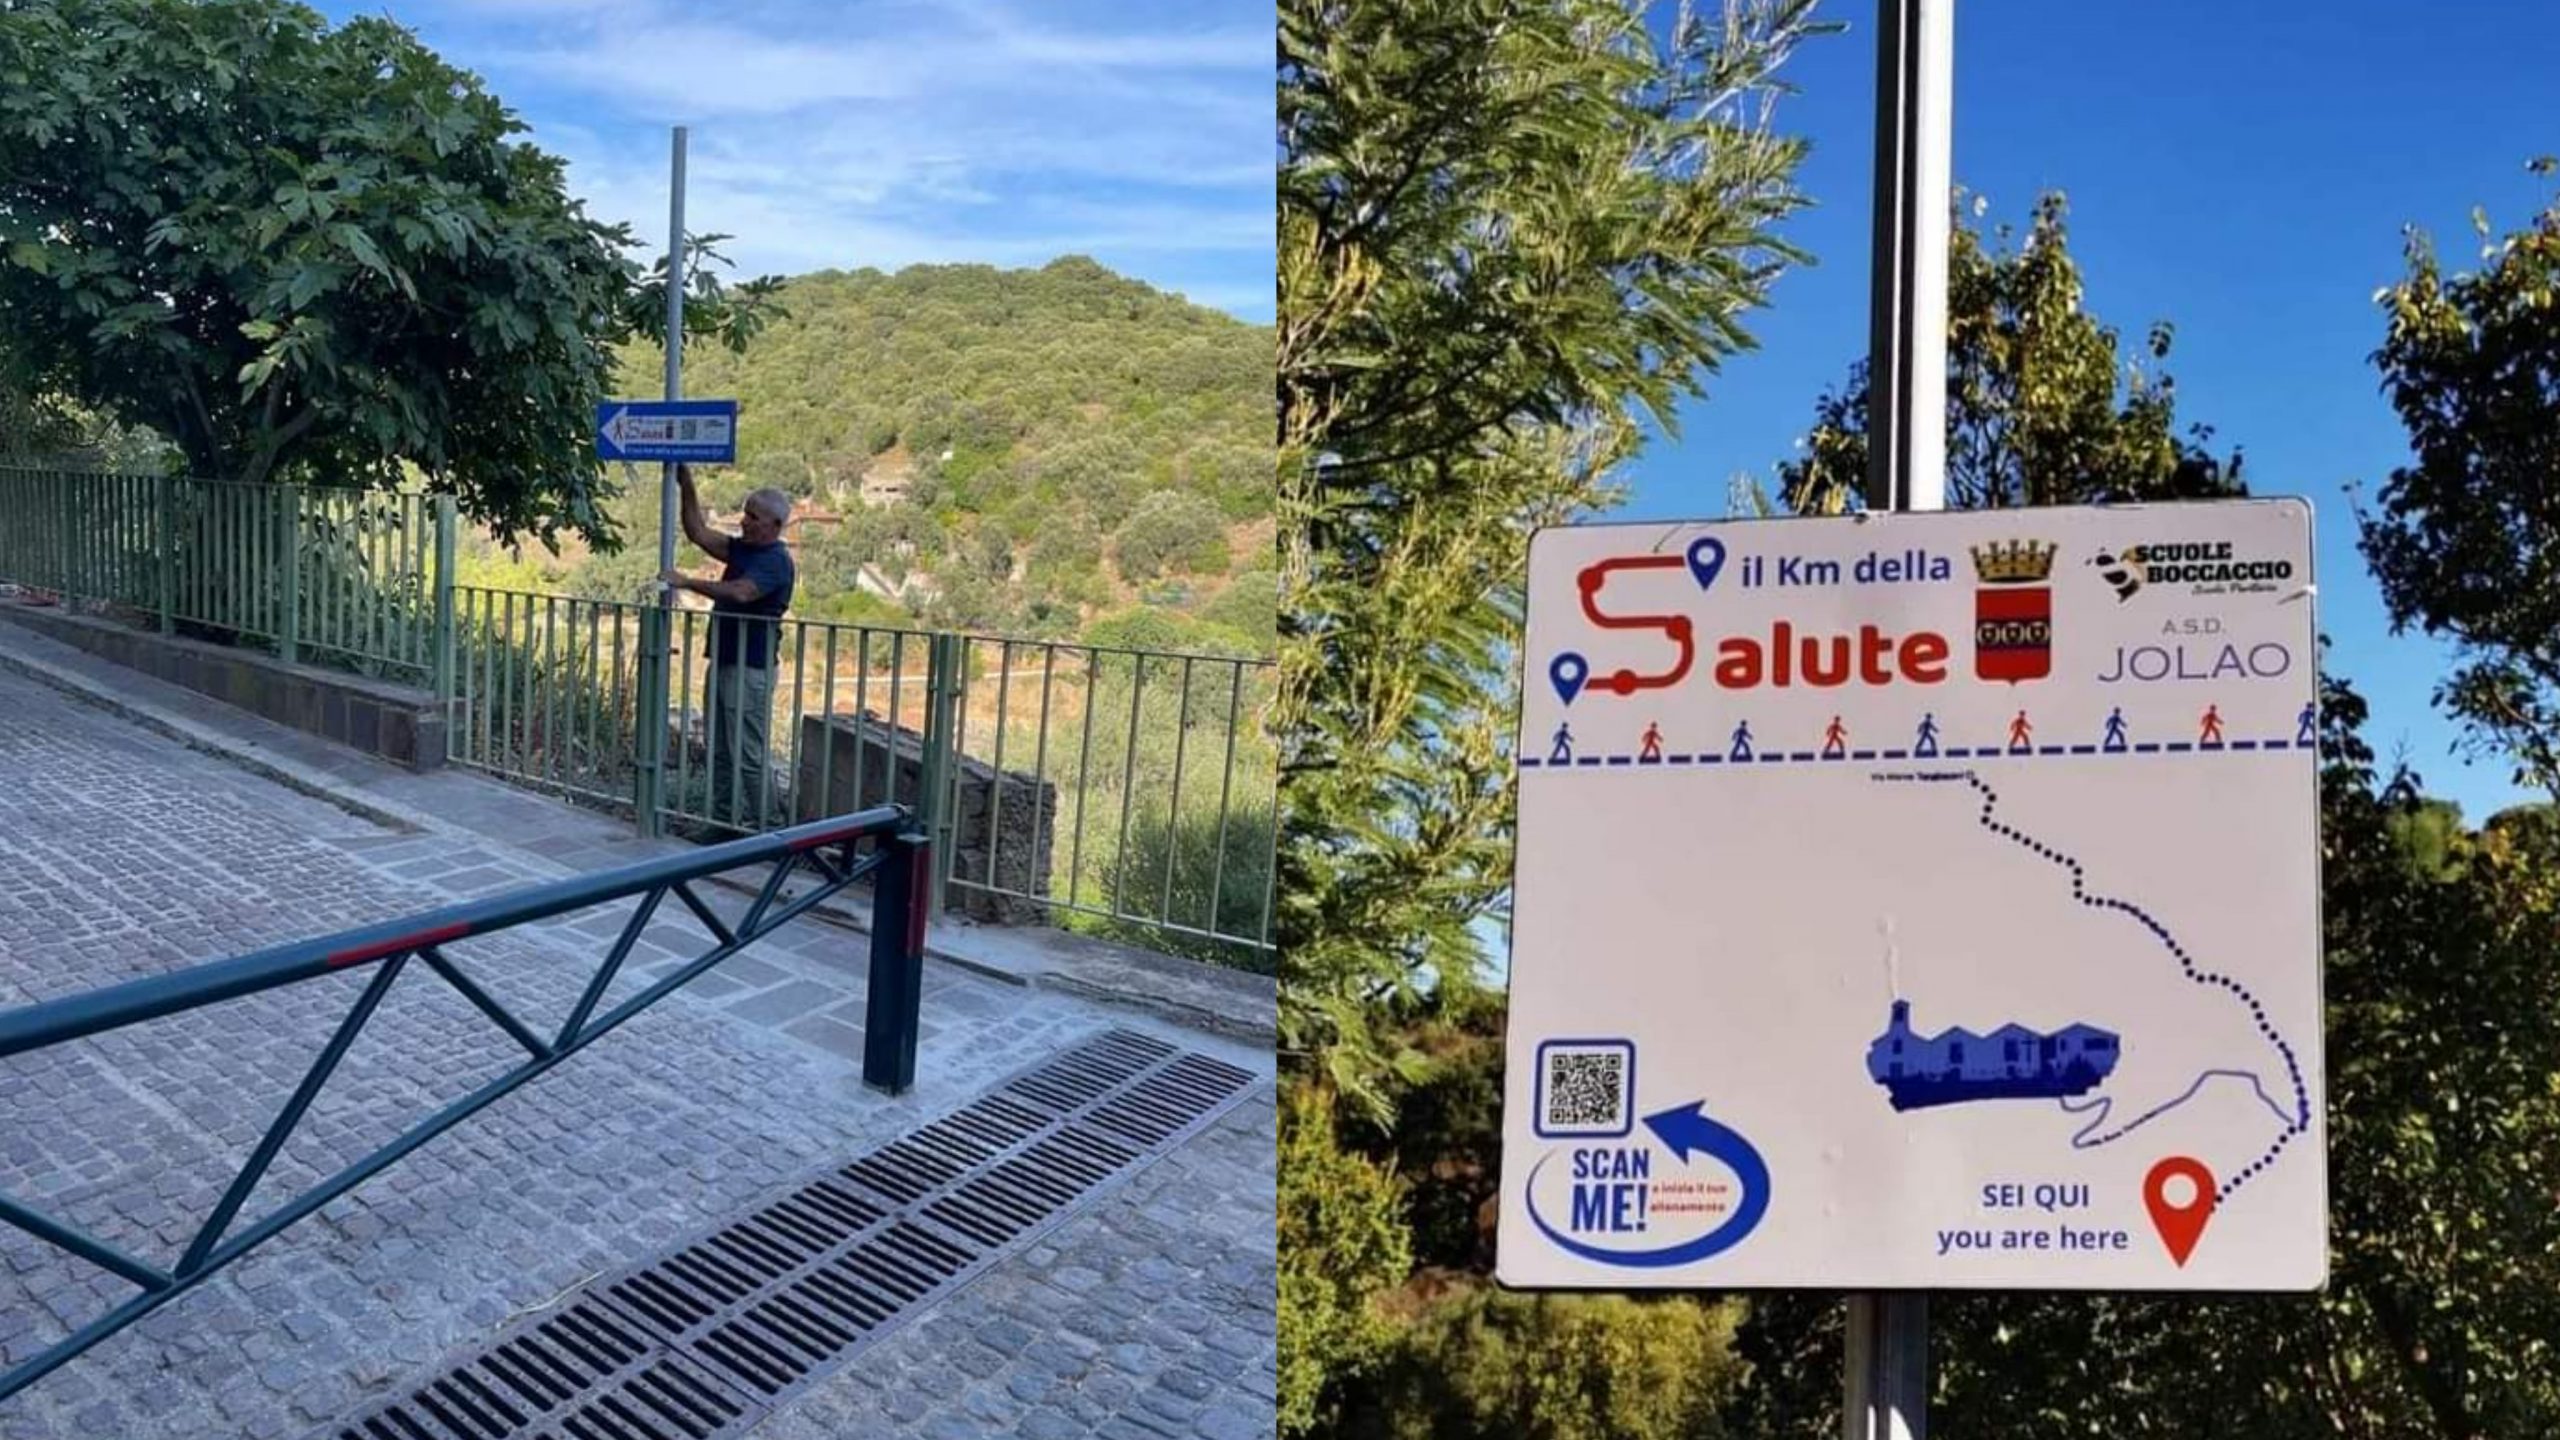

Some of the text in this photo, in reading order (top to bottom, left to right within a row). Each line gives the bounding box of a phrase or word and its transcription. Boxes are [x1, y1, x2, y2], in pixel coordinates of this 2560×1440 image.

[2134, 543, 2233, 563] SCUOLE
[1741, 551, 1951, 587] il Km della
[2147, 561, 2293, 583] BOCCACCIO
[2161, 618, 2226, 634] A.S.D.
[2097, 643, 2291, 682] JOLAO
[1572, 1148, 1650, 1179] SCAN
[1570, 1183, 1649, 1232] ME!
[1982, 1184, 2090, 1212] SEI QUI
[1937, 1225, 2129, 1256] you are here
